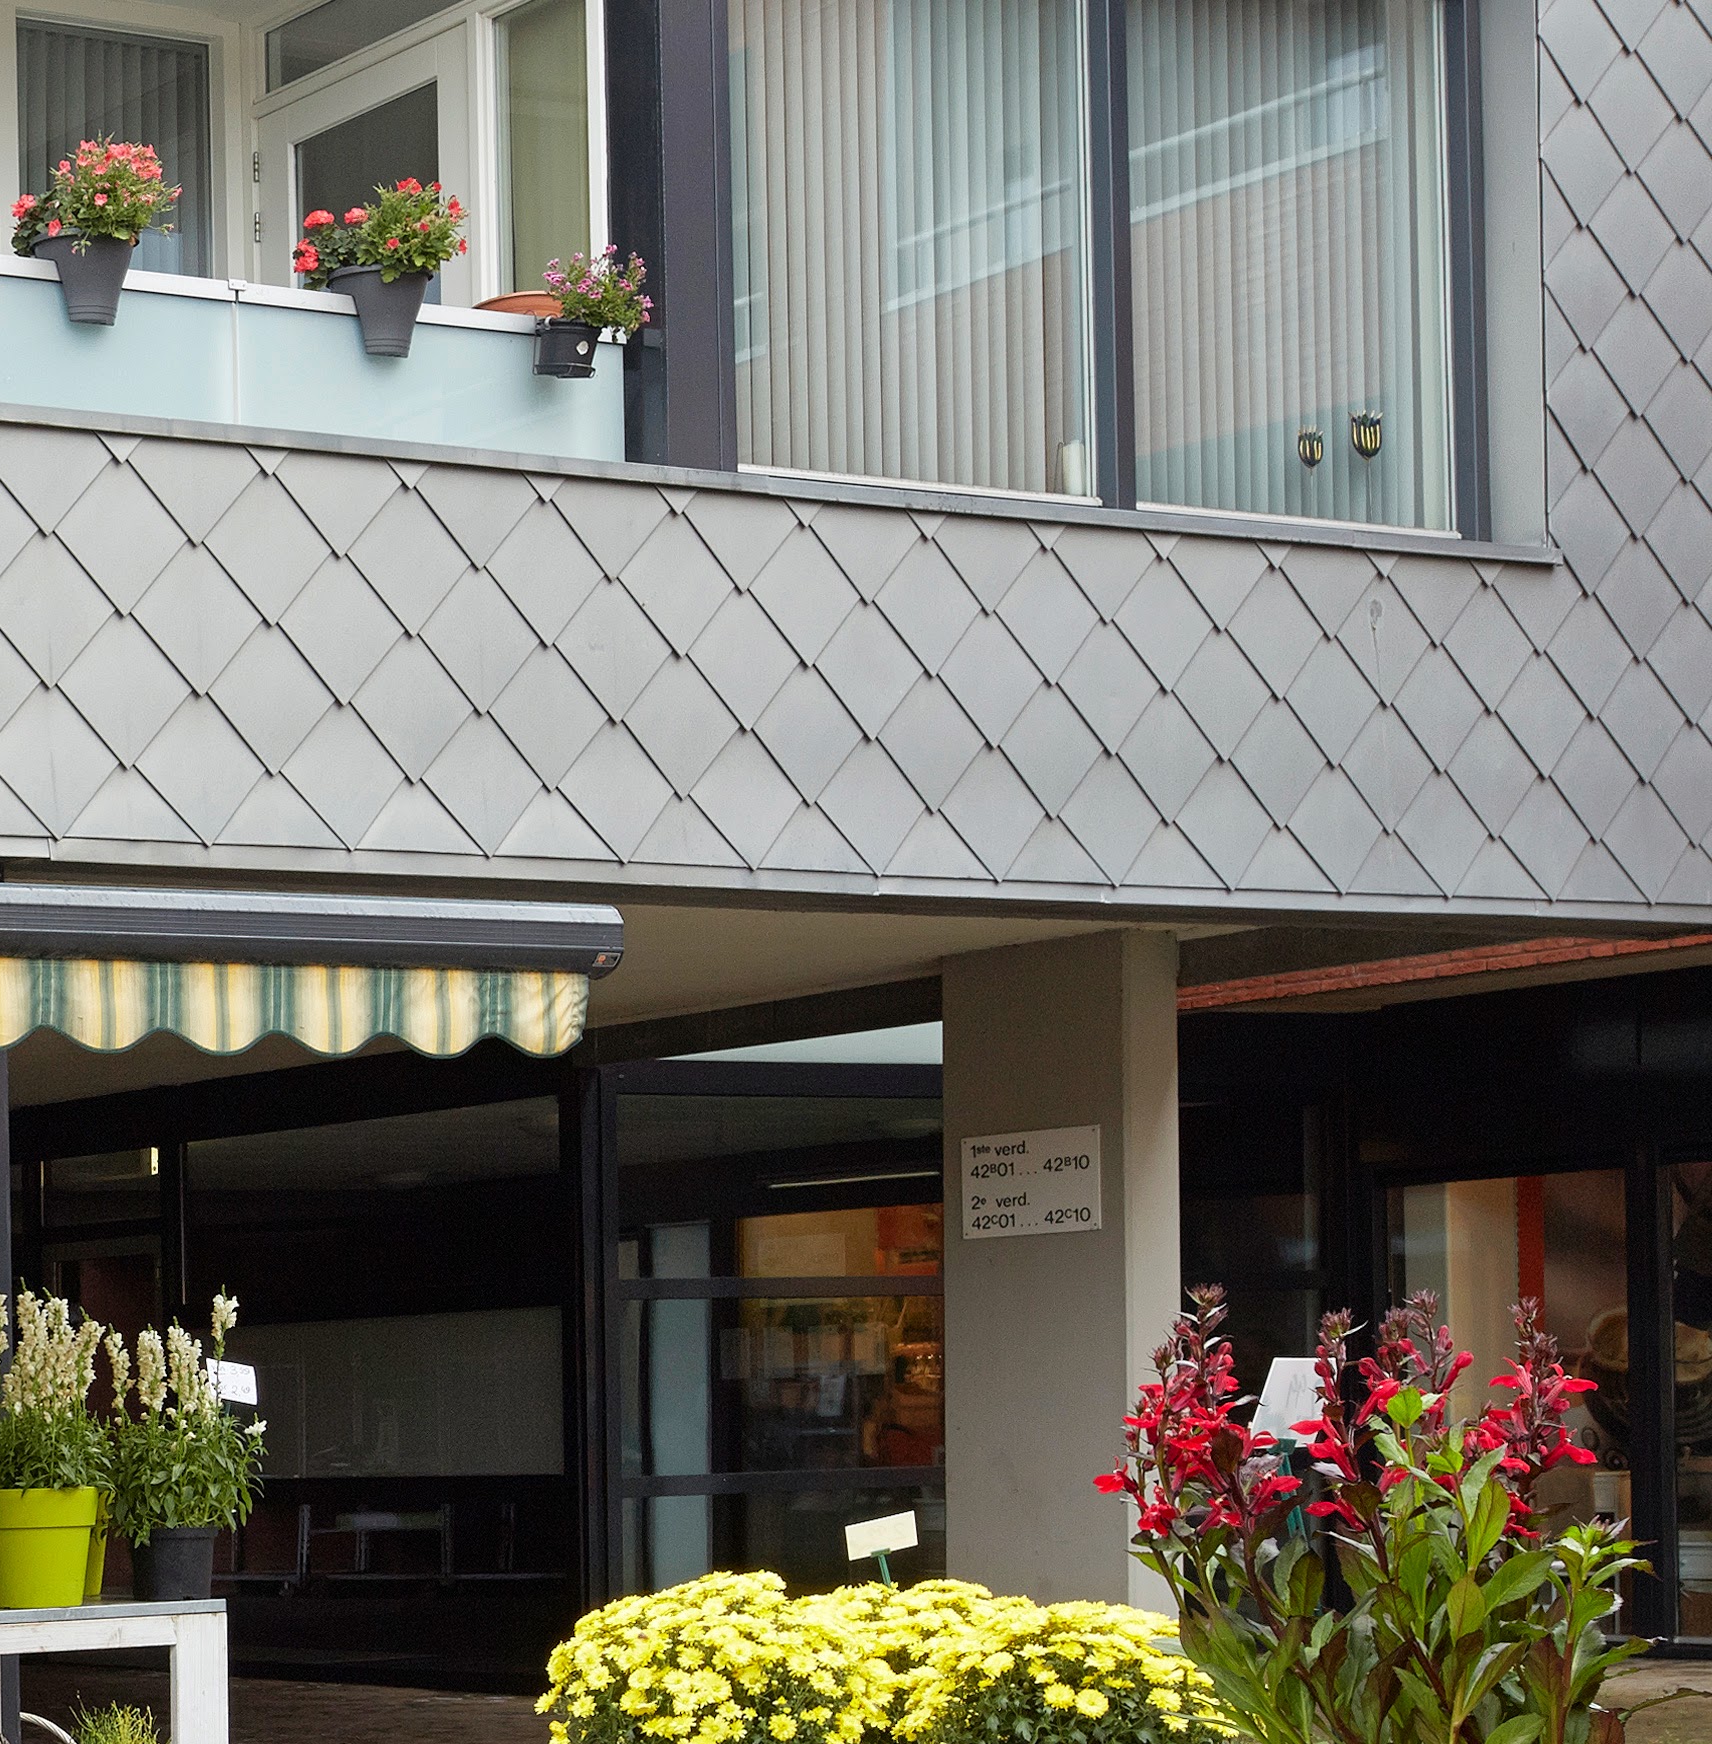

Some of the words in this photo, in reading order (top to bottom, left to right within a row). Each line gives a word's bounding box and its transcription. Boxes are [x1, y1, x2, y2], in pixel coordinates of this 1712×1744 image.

[994, 1140, 1030, 1156] verd.
[971, 1195, 987, 1210] 2e
[995, 1192, 1031, 1208] verd.
